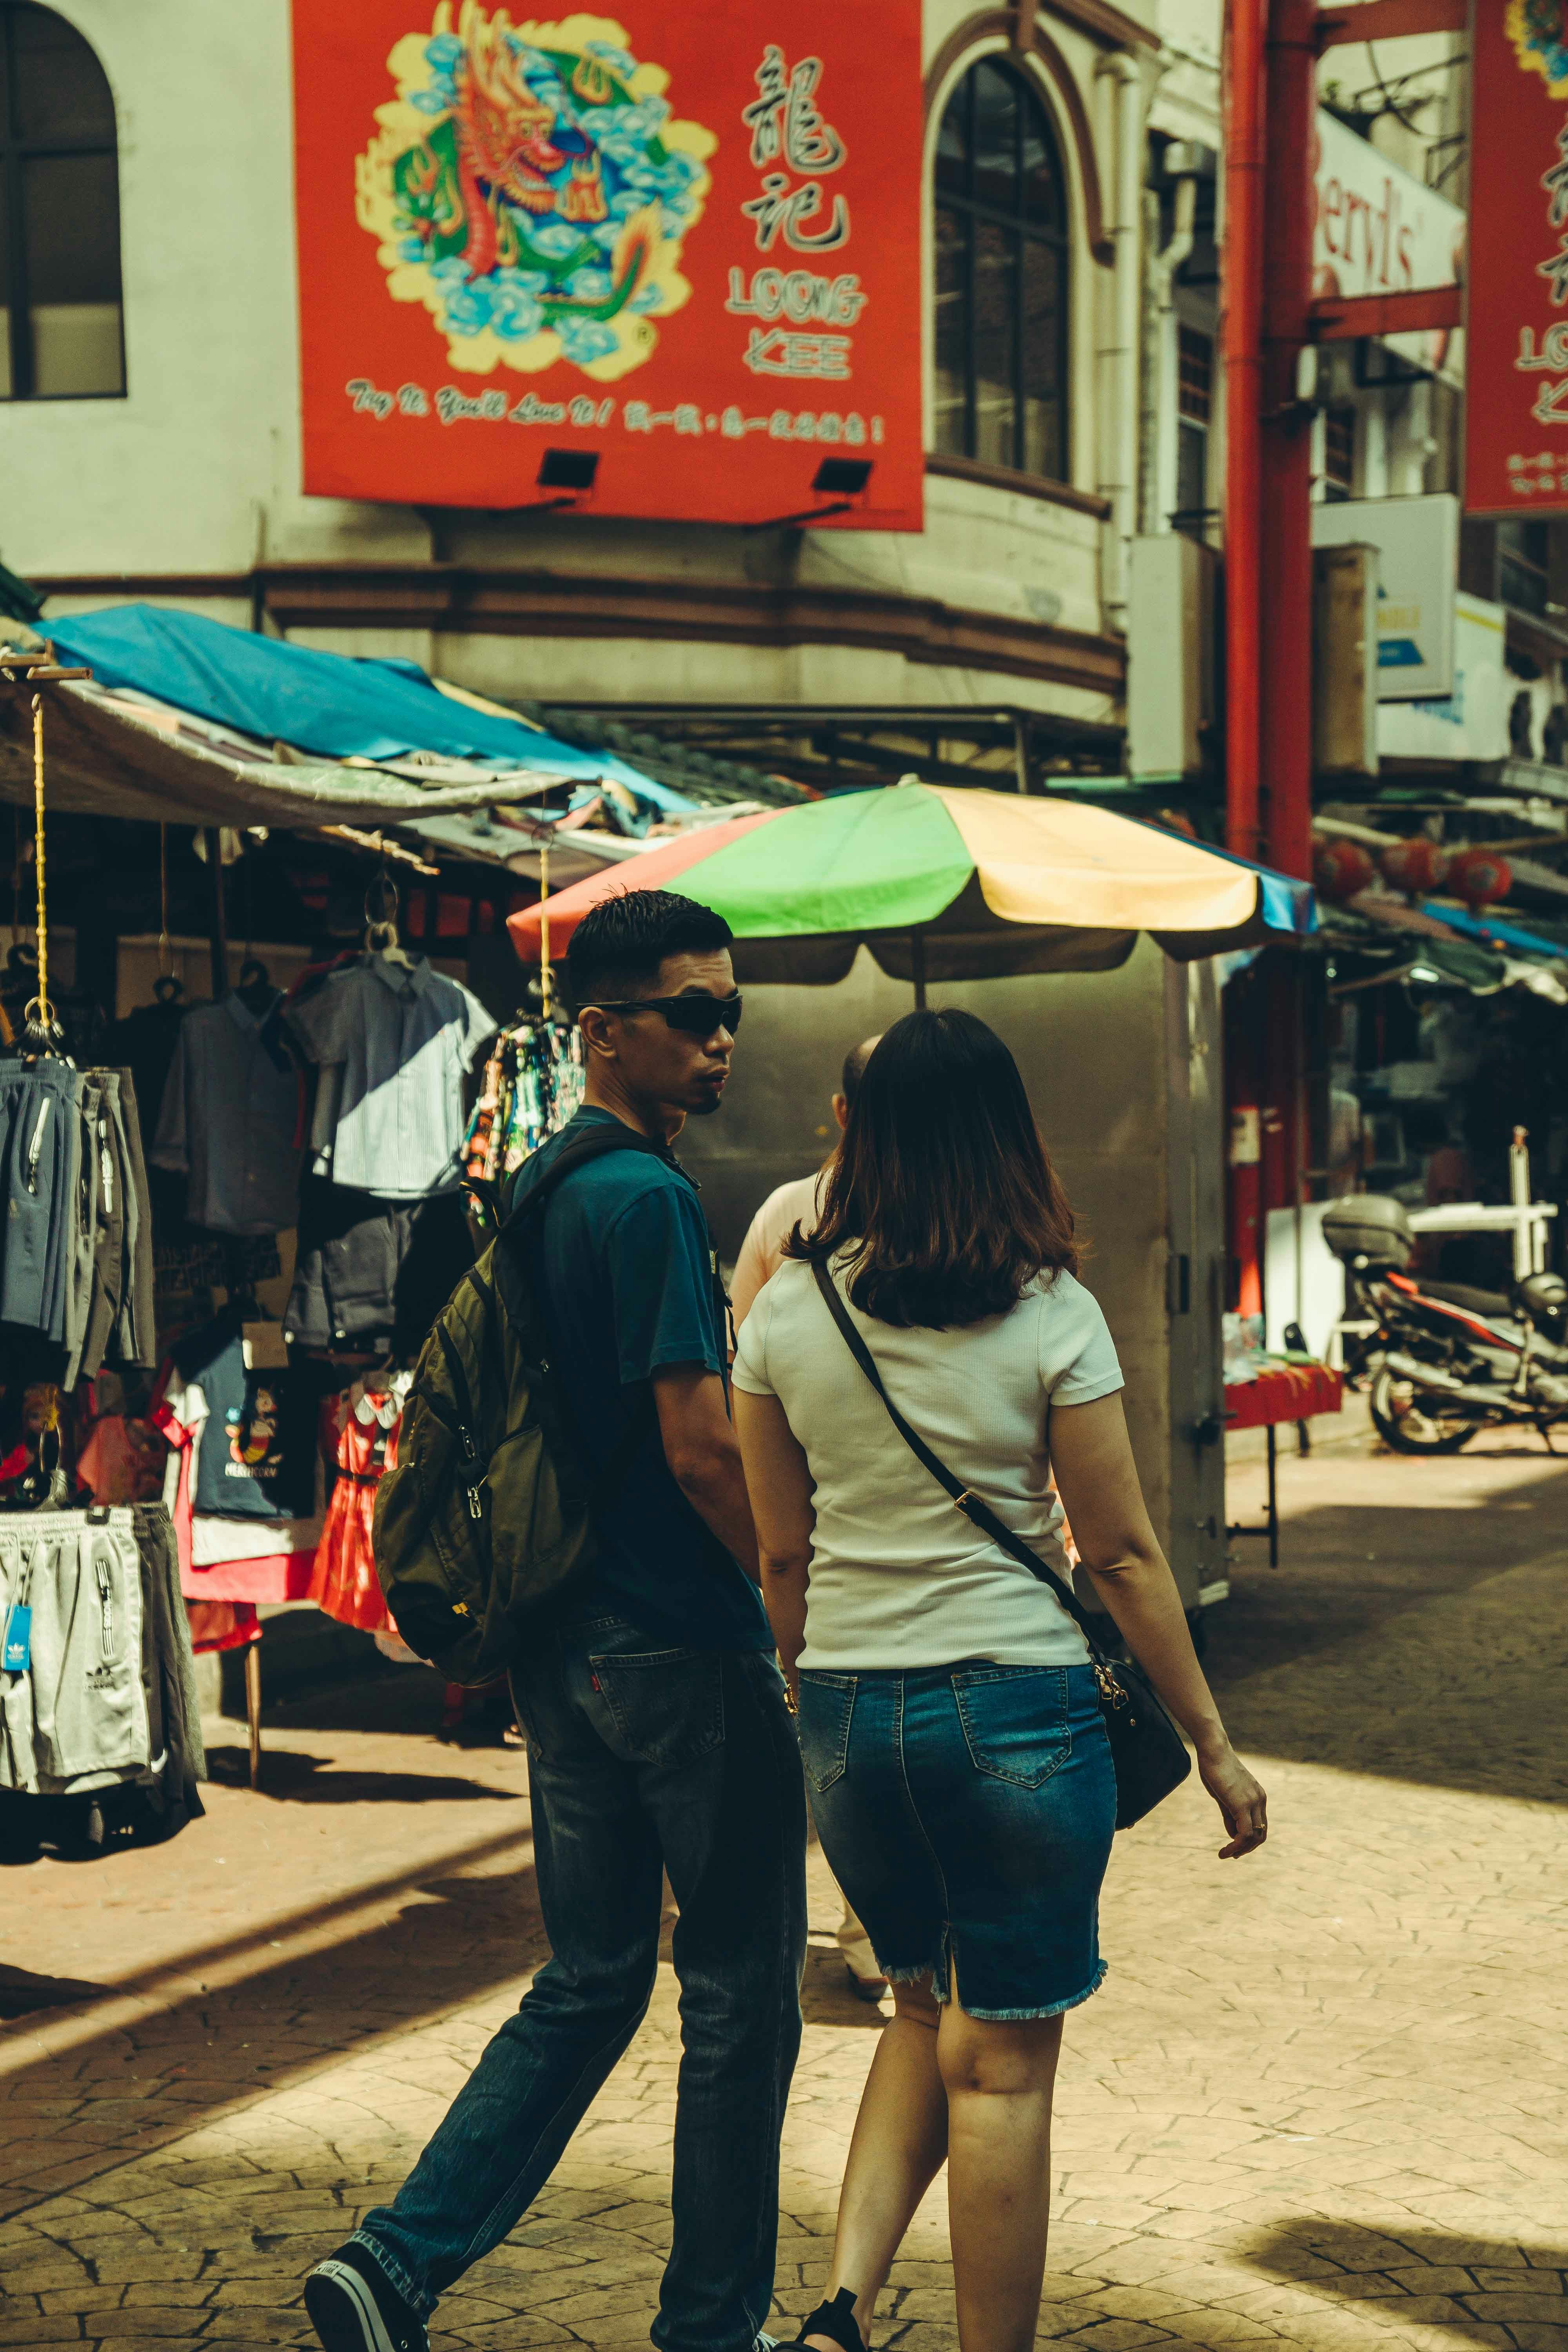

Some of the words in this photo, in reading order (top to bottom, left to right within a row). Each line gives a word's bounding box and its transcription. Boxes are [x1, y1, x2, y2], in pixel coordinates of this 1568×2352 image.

[742, 44, 849, 253] 龍記
[725, 267, 868, 326] LOONG
[743, 327, 852, 380] KEE
[346, 379, 394, 420] Try
[508, 392, 566, 425] Love
